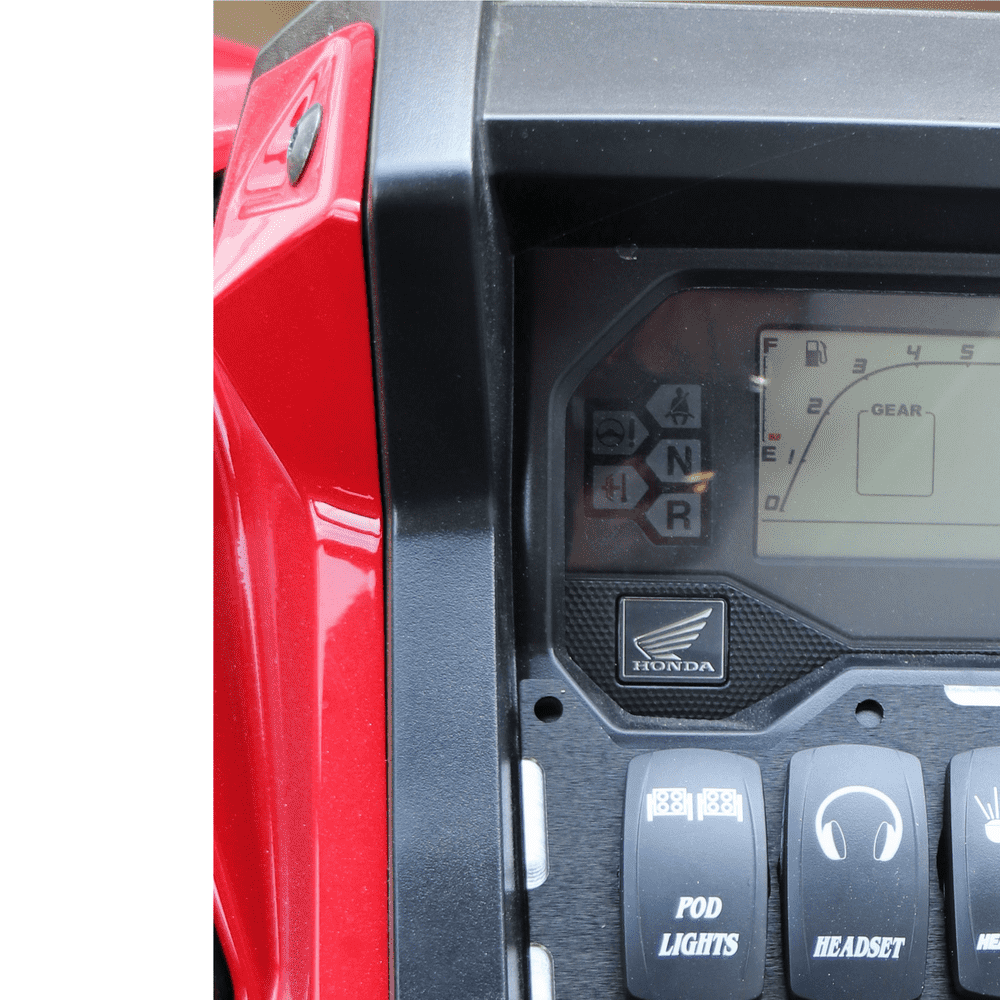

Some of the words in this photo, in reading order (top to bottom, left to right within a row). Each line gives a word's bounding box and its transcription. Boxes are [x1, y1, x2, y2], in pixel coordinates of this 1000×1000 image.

[762, 337, 778, 353] F
[906, 344, 922, 360] 4
[960, 344, 975, 360] 5
[852, 358, 868, 374] 3
[806, 397, 823, 415] 2
[870, 403, 922, 417] GEAR
[666, 445, 693, 476] N
[761, 445, 776, 462] E
[764, 495, 781, 511] 0
[666, 499, 692, 531] R
[631, 660, 716, 673] HONDA
[674, 895, 723, 920] POD
[657, 932, 740, 957] LIGHTS
[812, 935, 906, 959] HEADSET
